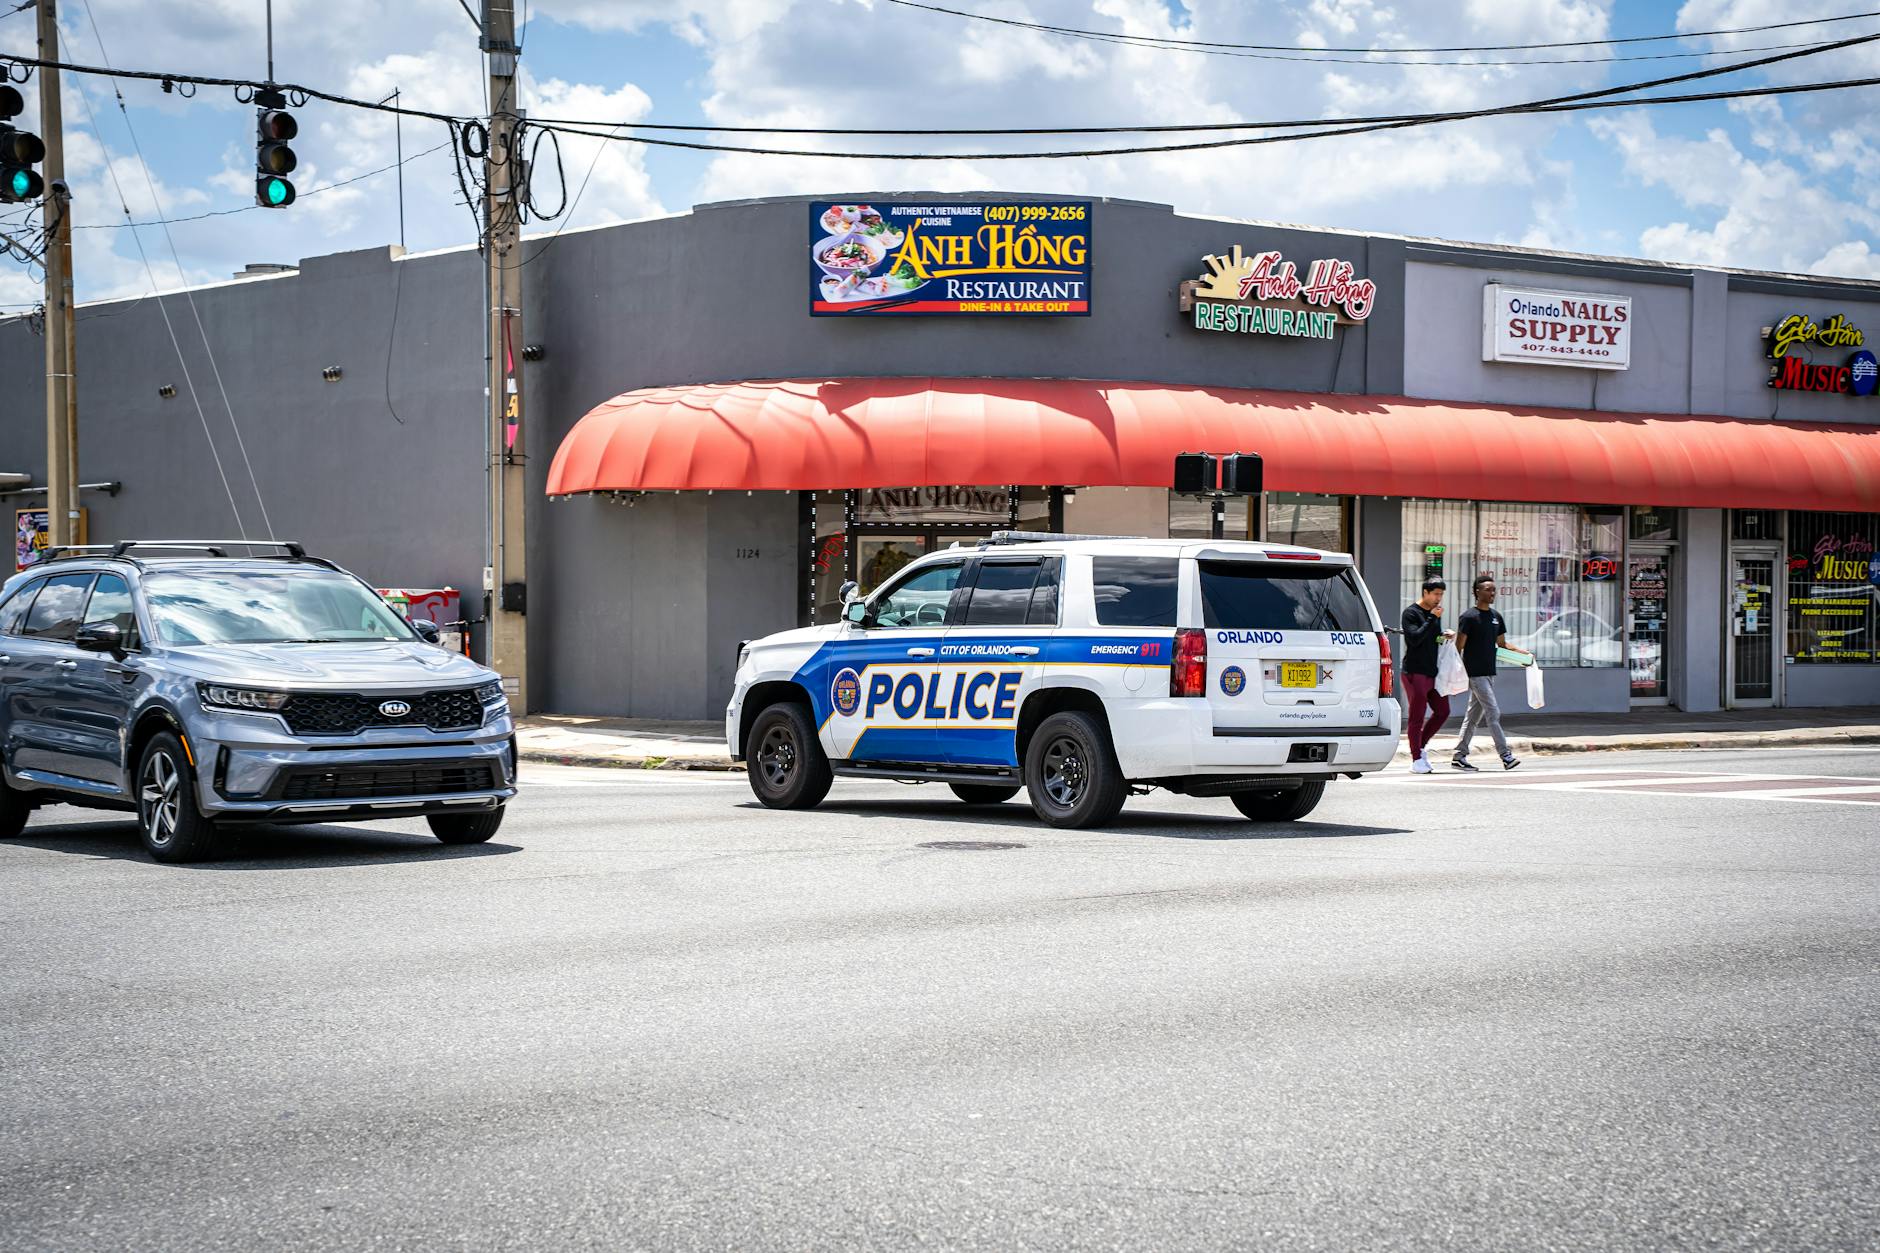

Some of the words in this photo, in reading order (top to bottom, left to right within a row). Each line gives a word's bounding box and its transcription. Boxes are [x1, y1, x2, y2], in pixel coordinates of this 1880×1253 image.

[891, 206, 934, 216] AUTHENTIC
[934, 206, 982, 216] VIETNAMESE
[984, 206, 1020, 222] (407)
[1022, 206, 1085, 220] 999-2656
[921, 217, 952, 226] CUISINE
[946, 280, 1084, 299] RESTAURANT
[959, 302, 1002, 312] DINE-IN
[1003, 302, 1012, 312] &
[1012, 302, 1044, 312] TAKE
[1046, 302, 1070, 312] OUT
[1509, 298, 1560, 318] Orlando
[1561, 300, 1627, 322] NAILS
[1196, 302, 1338, 340] RESTAURANT
[1510, 318, 1621, 345] SUPPLY
[1521, 343, 1609, 356] 407-843-4440
[736, 548, 760, 559] 1124
[1581, 560, 1617, 577] OPEN
[1217, 631, 1283, 644] ORLANDO
[1330, 632, 1366, 645] POLICE
[941, 645, 959, 655] CITY
[960, 645, 971, 655] OF
[972, 645, 1011, 655] ORLANDO
[1091, 645, 1139, 655] EMERGENCY
[1140, 643, 1160, 656] 911
[865, 671, 1023, 720] POLICE
[1279, 712, 1327, 720] orlando.gov/police
[1359, 709, 1374, 718] 10736
